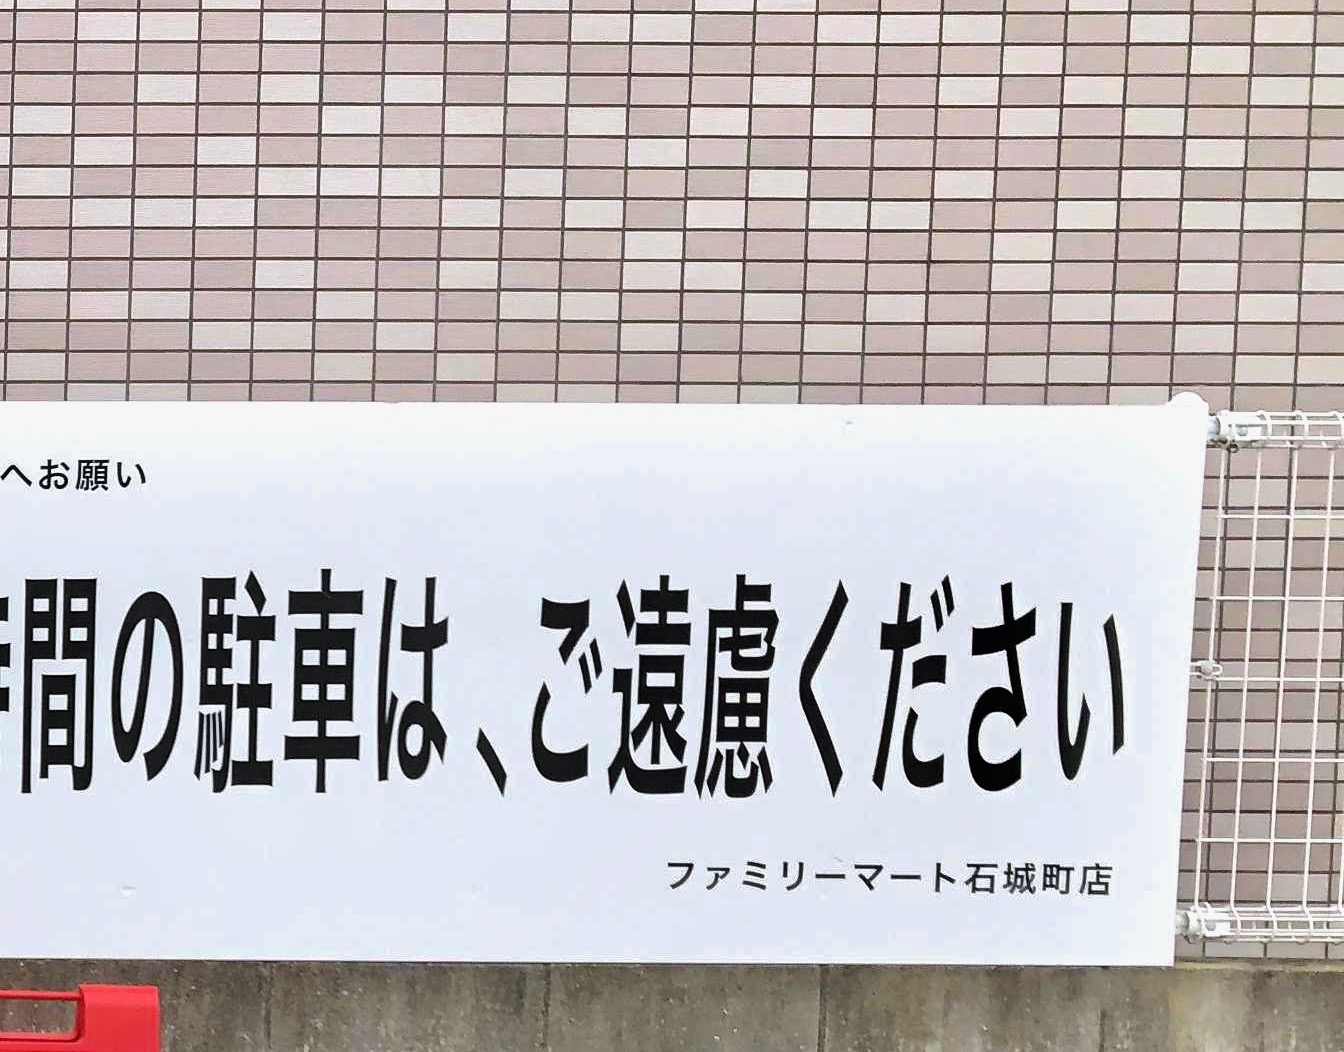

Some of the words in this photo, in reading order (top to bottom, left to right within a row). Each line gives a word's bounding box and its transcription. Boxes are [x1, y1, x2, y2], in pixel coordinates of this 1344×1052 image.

[668, 862, 1112, 895] ファミリーマート石城町店
